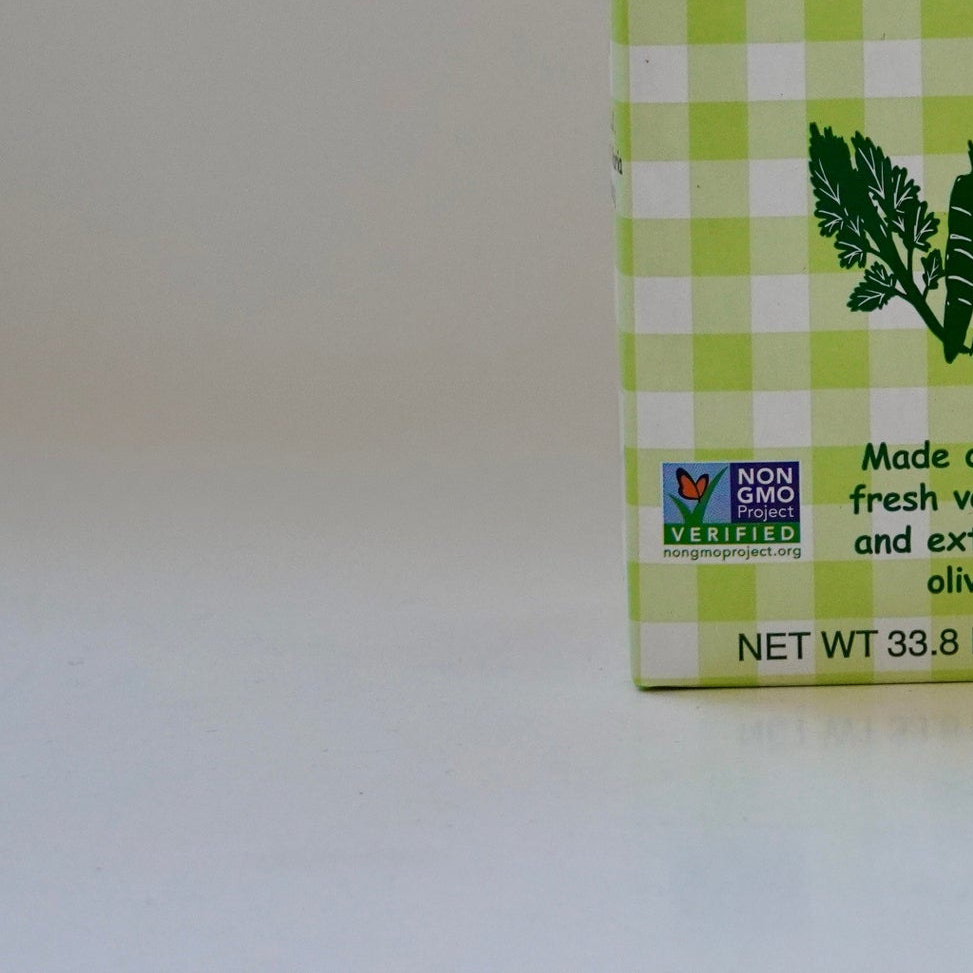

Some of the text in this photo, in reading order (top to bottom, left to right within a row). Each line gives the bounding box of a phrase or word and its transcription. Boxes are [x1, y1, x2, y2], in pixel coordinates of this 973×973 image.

[861, 440, 950, 470] Made
[738, 467, 793, 485] NON
[737, 486, 795, 504] GMO
[849, 482, 938, 515] fresh
[738, 504, 794, 522] Project
[671, 526, 795, 542] VERIFIED
[854, 525, 911, 554] and
[663, 545, 802, 561] nongmoproject.org
[738, 631, 811, 662] NET
[821, 629, 878, 658] WT
[887, 627, 960, 657] 33.8
